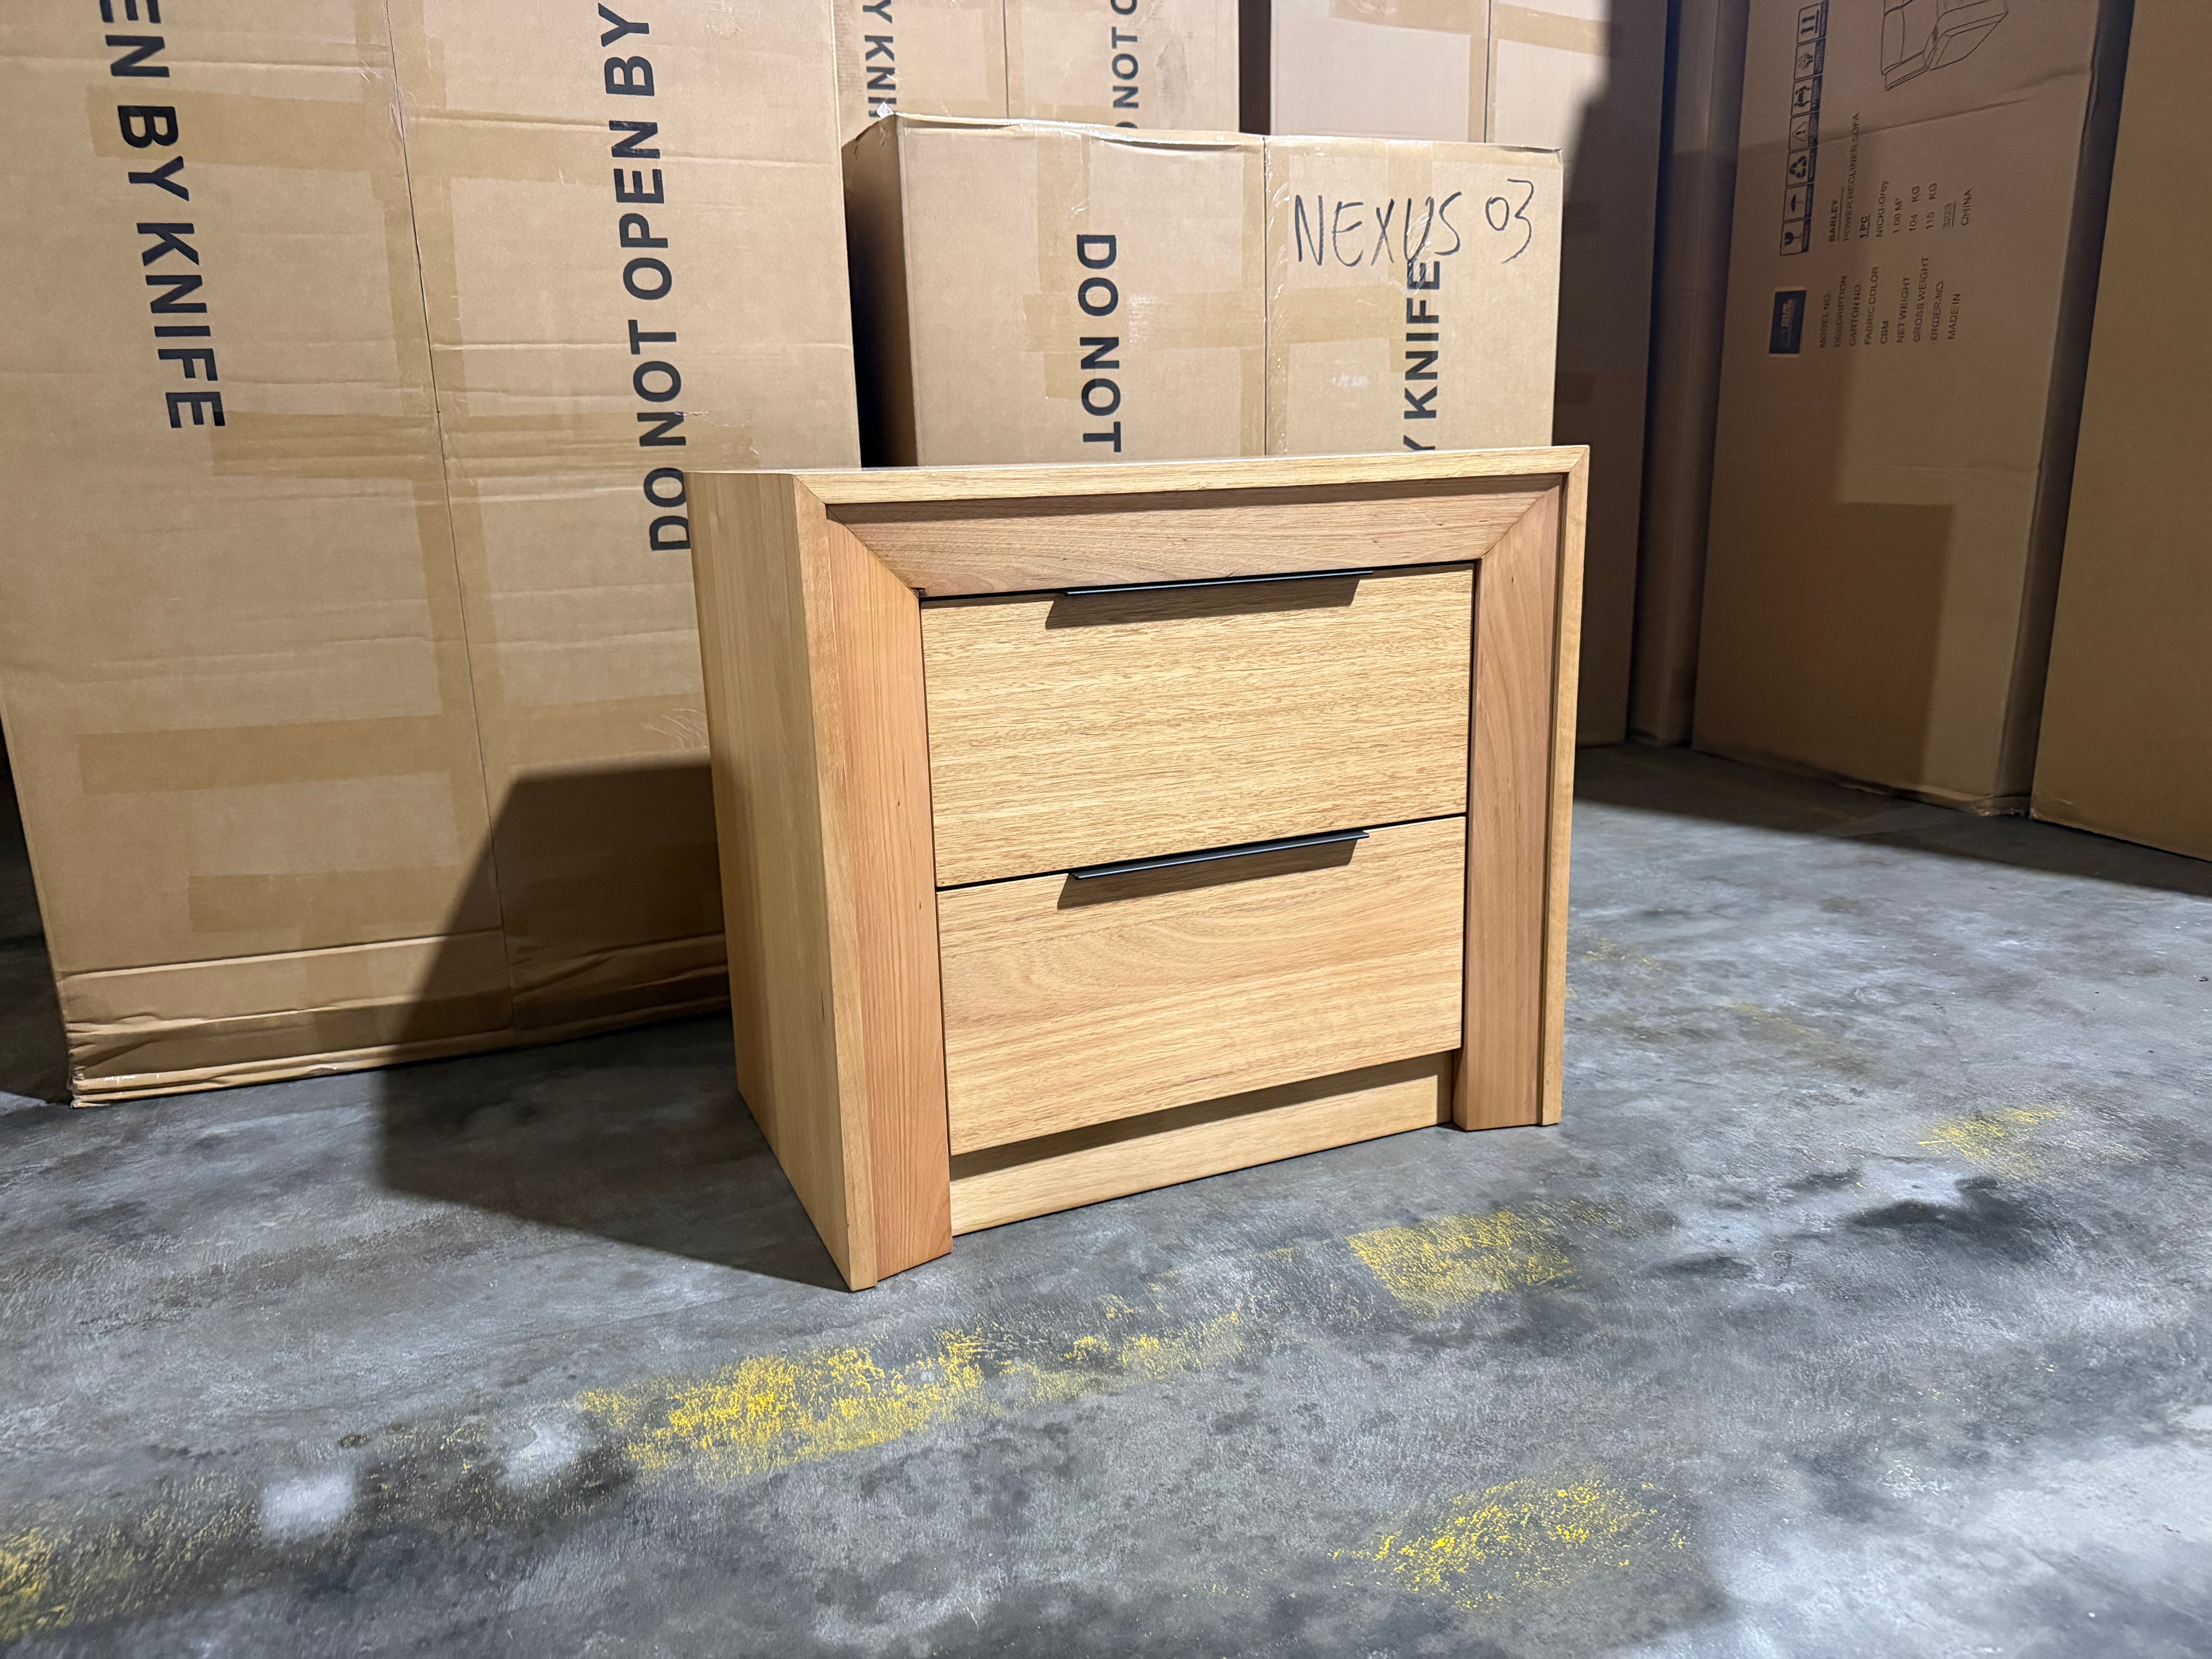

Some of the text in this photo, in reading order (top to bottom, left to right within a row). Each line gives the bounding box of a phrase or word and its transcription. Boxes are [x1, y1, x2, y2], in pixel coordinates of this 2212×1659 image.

[1111, 27, 1139, 108] NOT
[117, 105, 189, 201] BY
[1295, 179, 1534, 266] NEXUS 03
[1829, 200, 1838, 243] BARLEY
[1843, 201, 1853, 241] POWER
[1909, 186, 1920, 232] 104 KG
[1961, 188, 1972, 225] CHINA
[598, 3, 691, 551] DO NOT OPEN BY
[1834, 275, 1847, 347] DESCRIPTION
[1864, 266, 1879, 344] FABRIC COLOR
[1896, 276, 1910, 343] NET WEIGHT
[1913, 257, 1929, 342] GROSS WEIGHT
[136, 223, 225, 428] KNIFE
[1077, 235, 1121, 452] DO NOT
[1404, 261, 1440, 419] KNIFE
[1820, 313, 1829, 347] MODEL
[1850, 300, 1861, 346] CARTON
[1880, 321, 1889, 344] CBM
[1947, 294, 1961, 340] MADE IN
